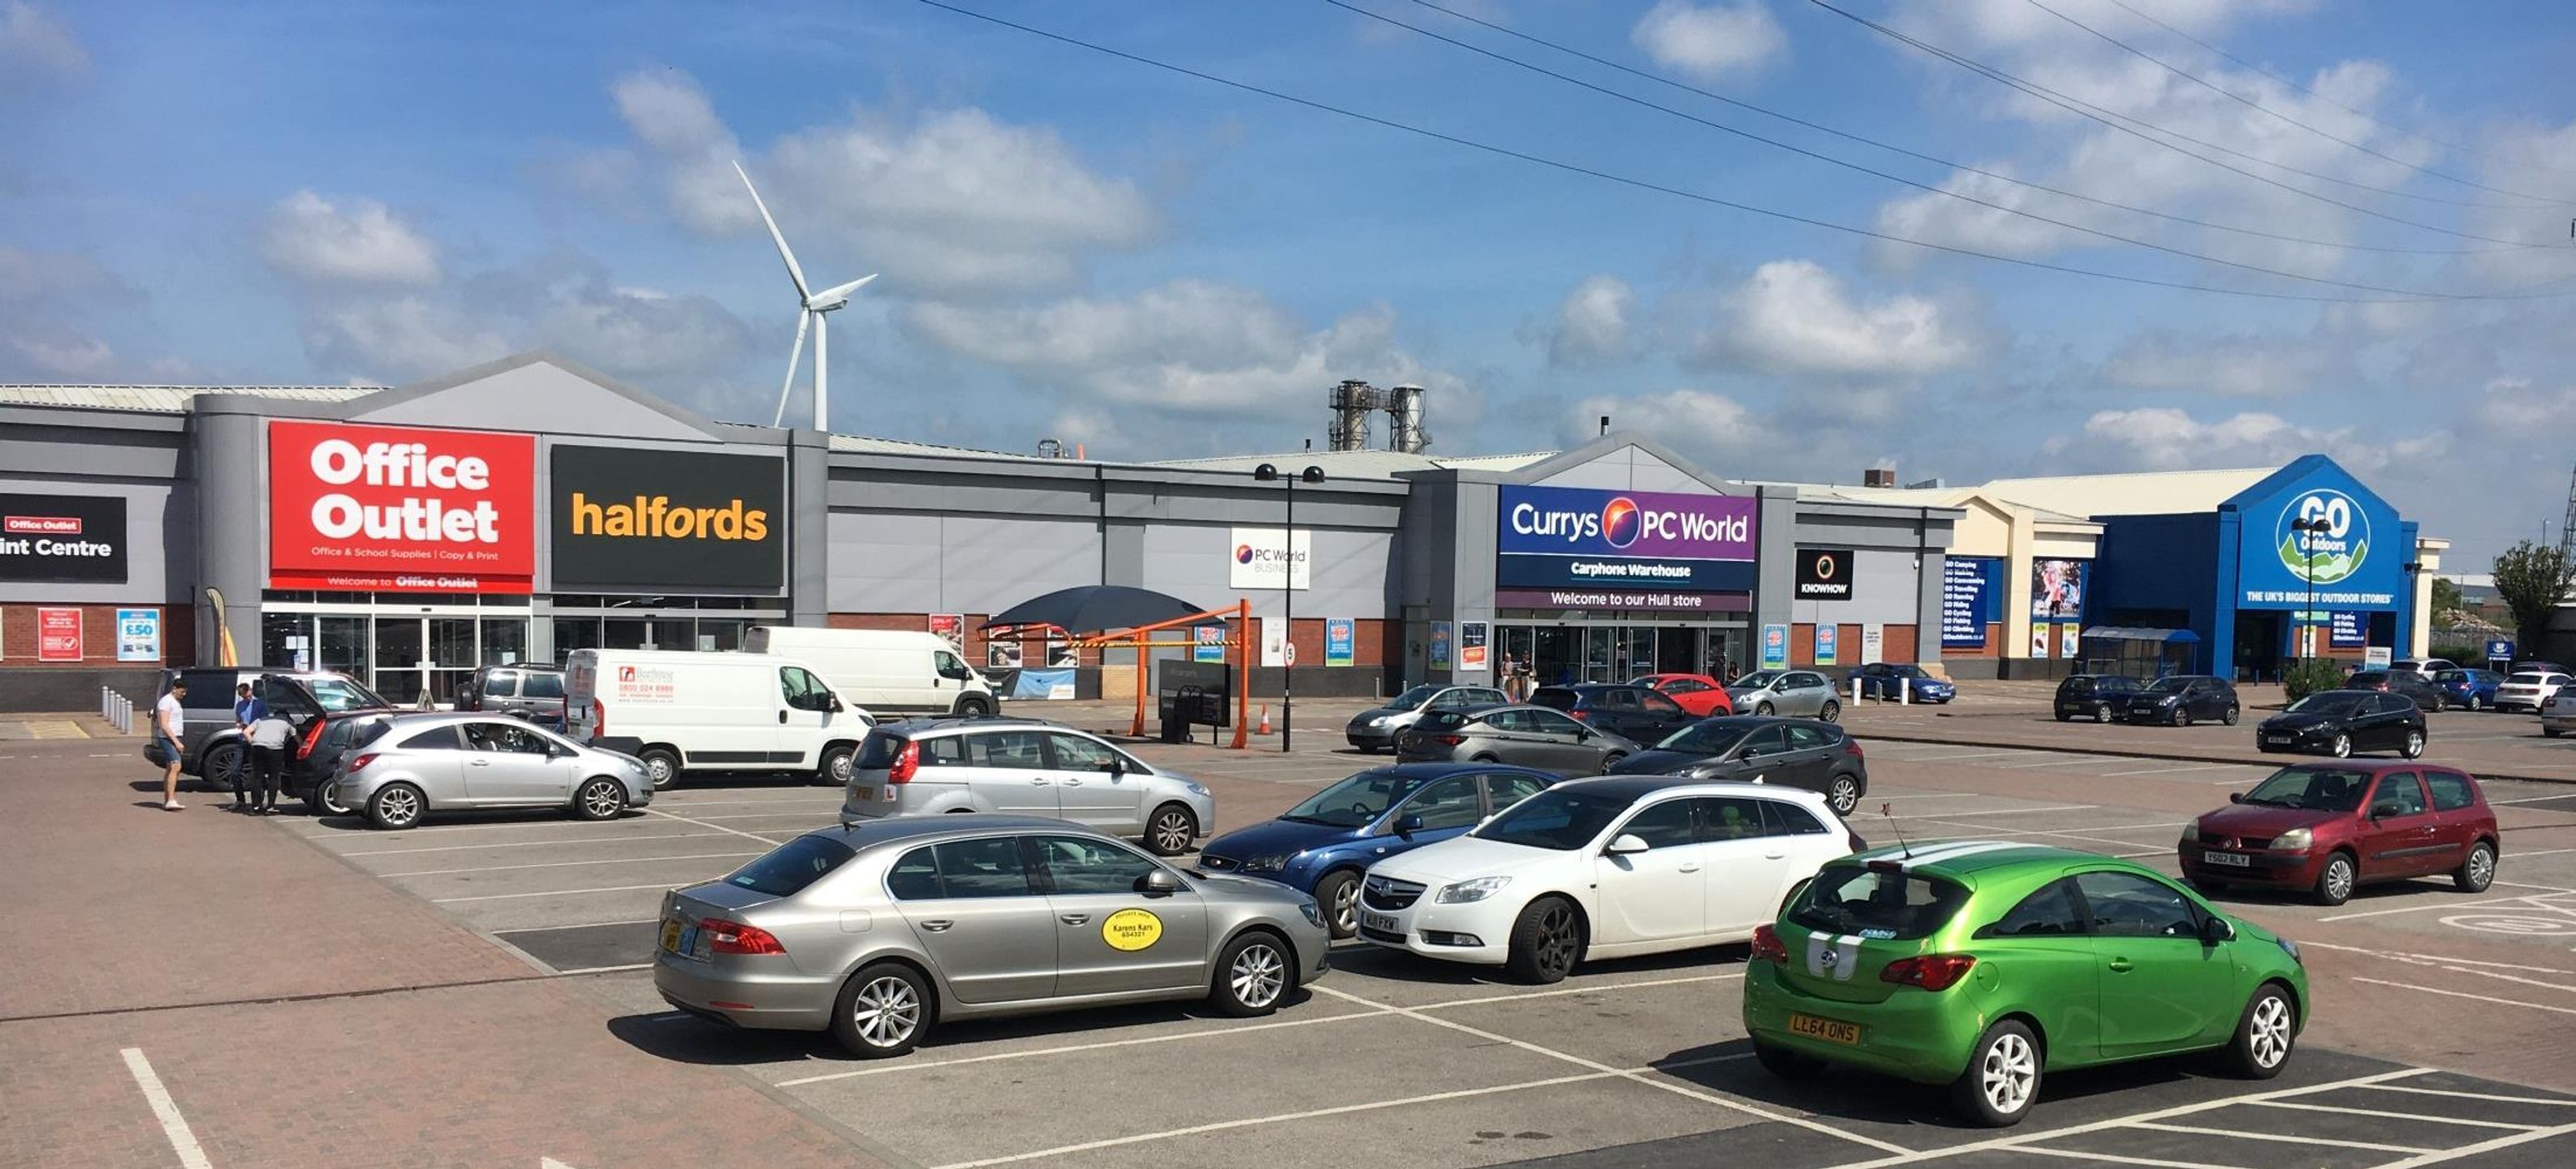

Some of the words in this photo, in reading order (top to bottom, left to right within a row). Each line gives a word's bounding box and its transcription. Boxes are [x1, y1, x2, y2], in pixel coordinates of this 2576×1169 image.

[310, 438, 489, 490] Office
[311, 494, 498, 543] Outlet
[572, 493, 768, 541] halfords
[1512, 503, 1599, 542] Currys
[1643, 511, 1677, 540] PC
[1681, 512, 1747, 542] World
[2300, 496, 2350, 538] GO
[10, 520, 41, 529] Office
[43, 520, 76, 530] Outlet
[35, 539, 112, 557] Centre
[312, 546, 341, 556] Office
[344, 547, 351, 556] &
[354, 547, 388, 557] School
[390, 549, 431, 559] Supplies
[439, 550, 464, 560] Copy
[467, 551, 473, 559] &
[477, 551, 498, 560] Print
[1255, 549, 1271, 561] PC
[1273, 550, 1305, 562] World
[1254, 563, 1299, 573] BUSINES
[1571, 562, 1626, 577] Carphone
[1628, 564, 1691, 577] Warehouse
[328, 576, 377, 586] Welcome
[381, 578, 391, 586] to
[395, 576, 435, 587] Office
[437, 576, 478, 589] Outlet
[1801, 584, 1847, 593] KNOWHOW
[1551, 592, 1607, 605] Welcome
[1610, 593, 1622, 605] to
[1625, 595, 1645, 606] our
[1648, 593, 1670, 606] Hull
[1673, 594, 1702, 606] store
[2246, 591, 2264, 602] THE
[2264, 592, 2284, 602] UK'S
[2322, 593, 2360, 603] OUTDOOR
[126, 624, 153, 636] £50
[1288, 648, 1292, 660] 5
[887, 788, 893, 799] L
[1113, 924, 1136, 932] Karens
[1828, 1023, 1855, 1041] ONS
